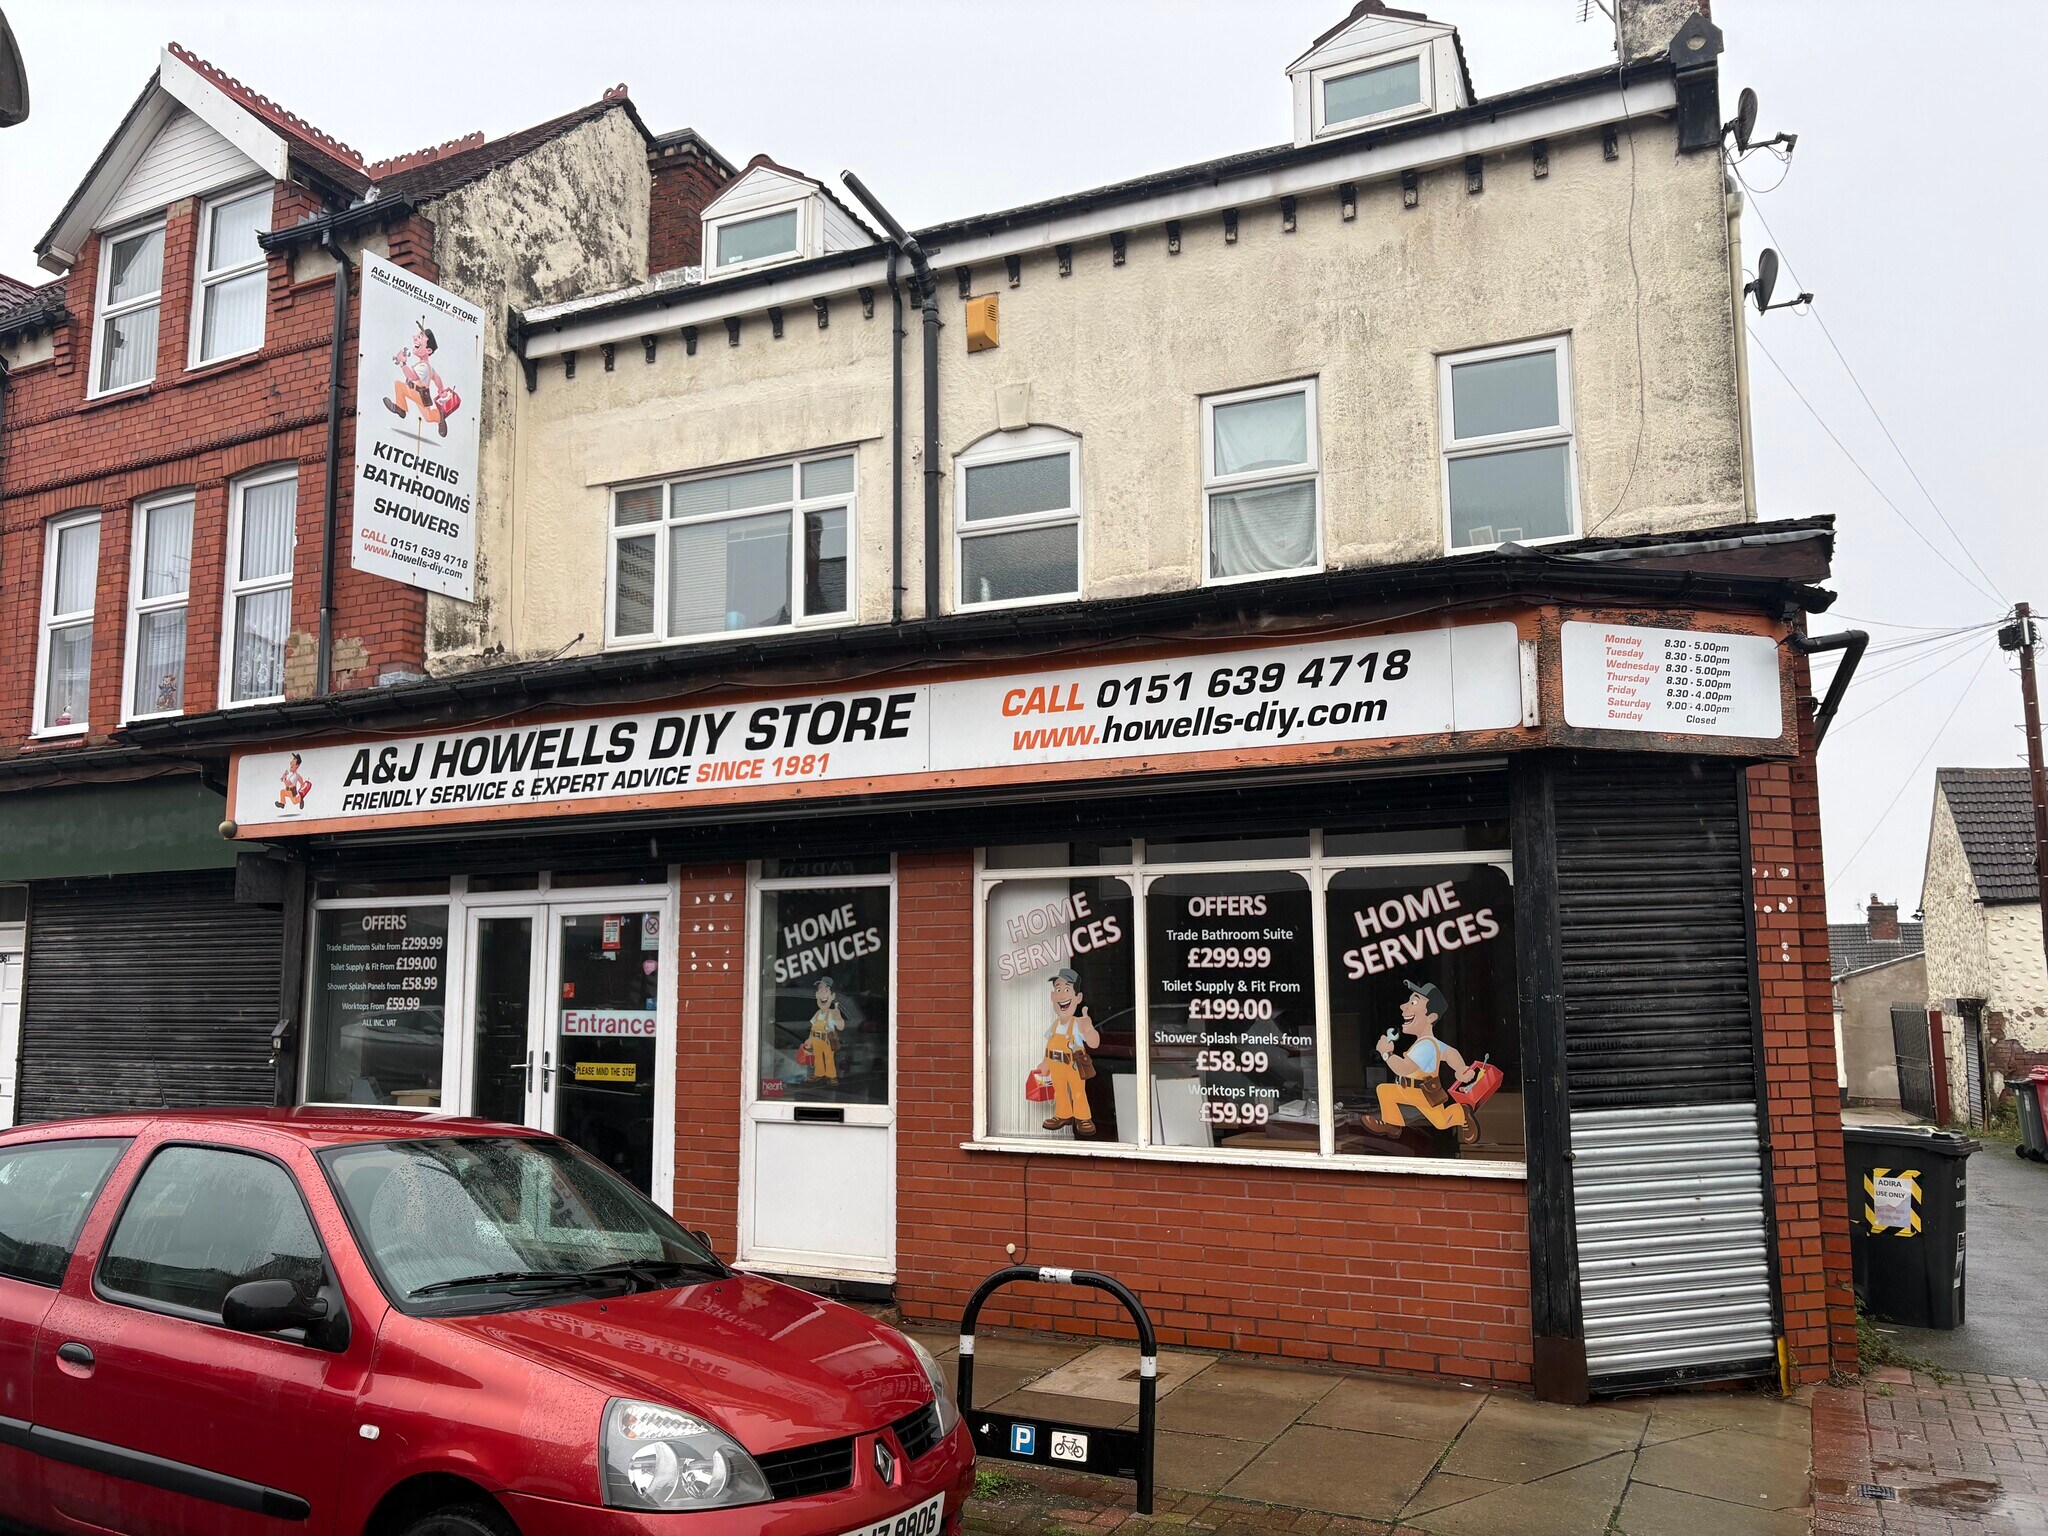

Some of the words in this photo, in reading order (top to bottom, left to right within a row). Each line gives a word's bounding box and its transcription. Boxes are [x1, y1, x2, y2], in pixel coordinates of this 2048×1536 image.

[371, 266, 391, 281] A&J
[391, 275, 435, 302] HOWELLS
[436, 297, 450, 310] DIY
[452, 306, 478, 324] STORE
[373, 441, 459, 485] KITCHENS
[362, 463, 470, 514] BATHROOMS
[373, 497, 460, 538] SHOWERS
[361, 528, 388, 545] CALL
[390, 537, 418, 553] 0151
[421, 547, 441, 561] 639
[443, 554, 469, 569] 4718
[364, 542, 463, 580] www.howells-diy.com
[1605, 634, 1642, 647] Monday
[1664, 639, 1686, 649] 8.30
[1694, 641, 1729, 652] 5.00pm
[1605, 647, 1644, 660] Tuesday
[1665, 651, 1687, 661] 8.30
[1695, 654, 1730, 664] 5.00pm
[1606, 659, 1660, 673] Wednesday
[1665, 664, 1687, 673] 8.30
[1695, 666, 1731, 677] 5.00pm
[1001, 682, 1084, 718] CALL
[1096, 671, 1193, 708] 0151
[1206, 662, 1284, 698] 639
[1296, 648, 1412, 687] 4718
[1607, 672, 1650, 685] Thursday
[1666, 676, 1688, 686] 8.30
[1696, 678, 1731, 689] 5.00pm
[1607, 684, 1637, 697] Friday
[1666, 689, 1688, 698] 8.30
[1695, 691, 1732, 701] 4.00pm
[1607, 697, 1651, 710] Saturday
[1666, 701, 1687, 711] 9.00
[1695, 703, 1730, 714] 4.00pm
[1012, 699, 1388, 751] www.howells-diy.com
[1608, 709, 1643, 722] Sunday
[1686, 715, 1716, 725] Closed
[343, 743, 424, 787] A&J
[430, 721, 638, 779] HOWELLS
[649, 711, 736, 760] DIY
[745, 693, 916, 751] STORE
[342, 788, 427, 812] FRIENDLY
[430, 781, 508, 805] SERVICE
[511, 780, 525, 797] &
[530, 772, 609, 796] EXPERT
[612, 765, 691, 789] ADVICE
[696, 758, 765, 783] SINCE
[771, 753, 830, 776] 1981
[1188, 895, 1267, 917] OFFERS
[1354, 880, 1461, 939] HOME
[362, 914, 407, 931] OFFERS
[783, 904, 857, 949] HOME
[1007, 891, 1092, 944] HOME
[342, 943, 370, 951] Bathroom
[371, 942, 385, 950] Suite
[401, 936, 443, 950] £299.99
[1166, 930, 1198, 941] Trade
[1201, 929, 1260, 940] Bathroom
[1263, 928, 1294, 940] Suite
[1343, 908, 1500, 980] SERVICES
[773, 927, 881, 983] SERVICES
[997, 916, 1122, 981] SERVICES
[1187, 947, 1271, 968] £299.99
[330, 963, 344, 971] Toilet
[345, 963, 364, 972] Supply
[396, 956, 437, 970] £199.00
[348, 982, 366, 991] Splash
[367, 982, 385, 990] Panels
[386, 982, 400, 990] from
[402, 977, 437, 990] £58.99
[1162, 980, 1192, 992] Toilet
[1195, 980, 1234, 995] Supply
[1237, 981, 1248, 992] &
[1251, 980, 1266, 992] Fit
[1269, 981, 1300, 992] From
[342, 1002, 369, 1011] Worktops
[386, 997, 420, 1011] £59.99
[1188, 999, 1272, 1020] £199.00
[362, 1019, 372, 1027] ALL
[374, 1019, 385, 1027] INC.
[386, 1019, 397, 1027] VAT
[564, 1012, 655, 1034] Entrance
[1154, 1031, 1197, 1043] Shower
[1200, 1031, 1237, 1046] Splash
[1241, 1032, 1279, 1045] Panels
[1281, 1033, 1312, 1046] from
[576, 1066, 594, 1075] PLEASE
[596, 1067, 609, 1076] MIND
[611, 1067, 620, 1076] THE
[622, 1067, 635, 1076] STEP
[1196, 1051, 1269, 1072] £58.99
[762, 1081, 783, 1091] heart
[1188, 1084, 1245, 1098] Worktops
[1249, 1086, 1279, 1098] From
[1200, 1102, 1269, 1125] £59.99
[1876, 1190, 1888, 1198] USE
[1889, 1191, 1905, 1199] ONLY
[1878, 1180, 1902, 1188] ADIRA
[1016, 1427, 1031, 1450] P
